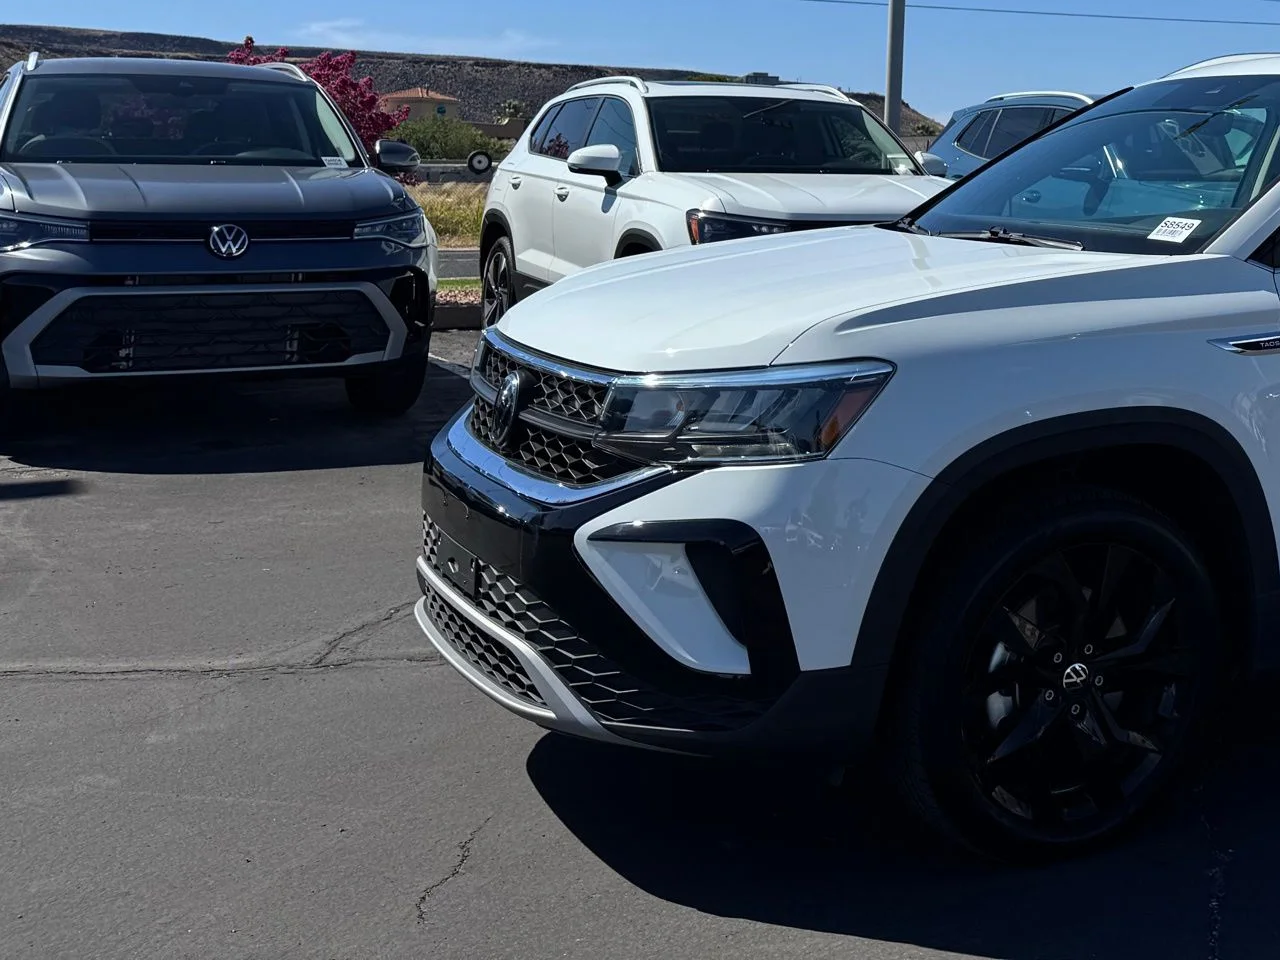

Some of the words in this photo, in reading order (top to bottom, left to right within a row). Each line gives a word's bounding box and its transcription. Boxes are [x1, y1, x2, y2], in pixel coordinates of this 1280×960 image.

[1160, 220, 1195, 231] S8549
[210, 224, 248, 256] VW
[1260, 340, 1280, 348] TAOS
